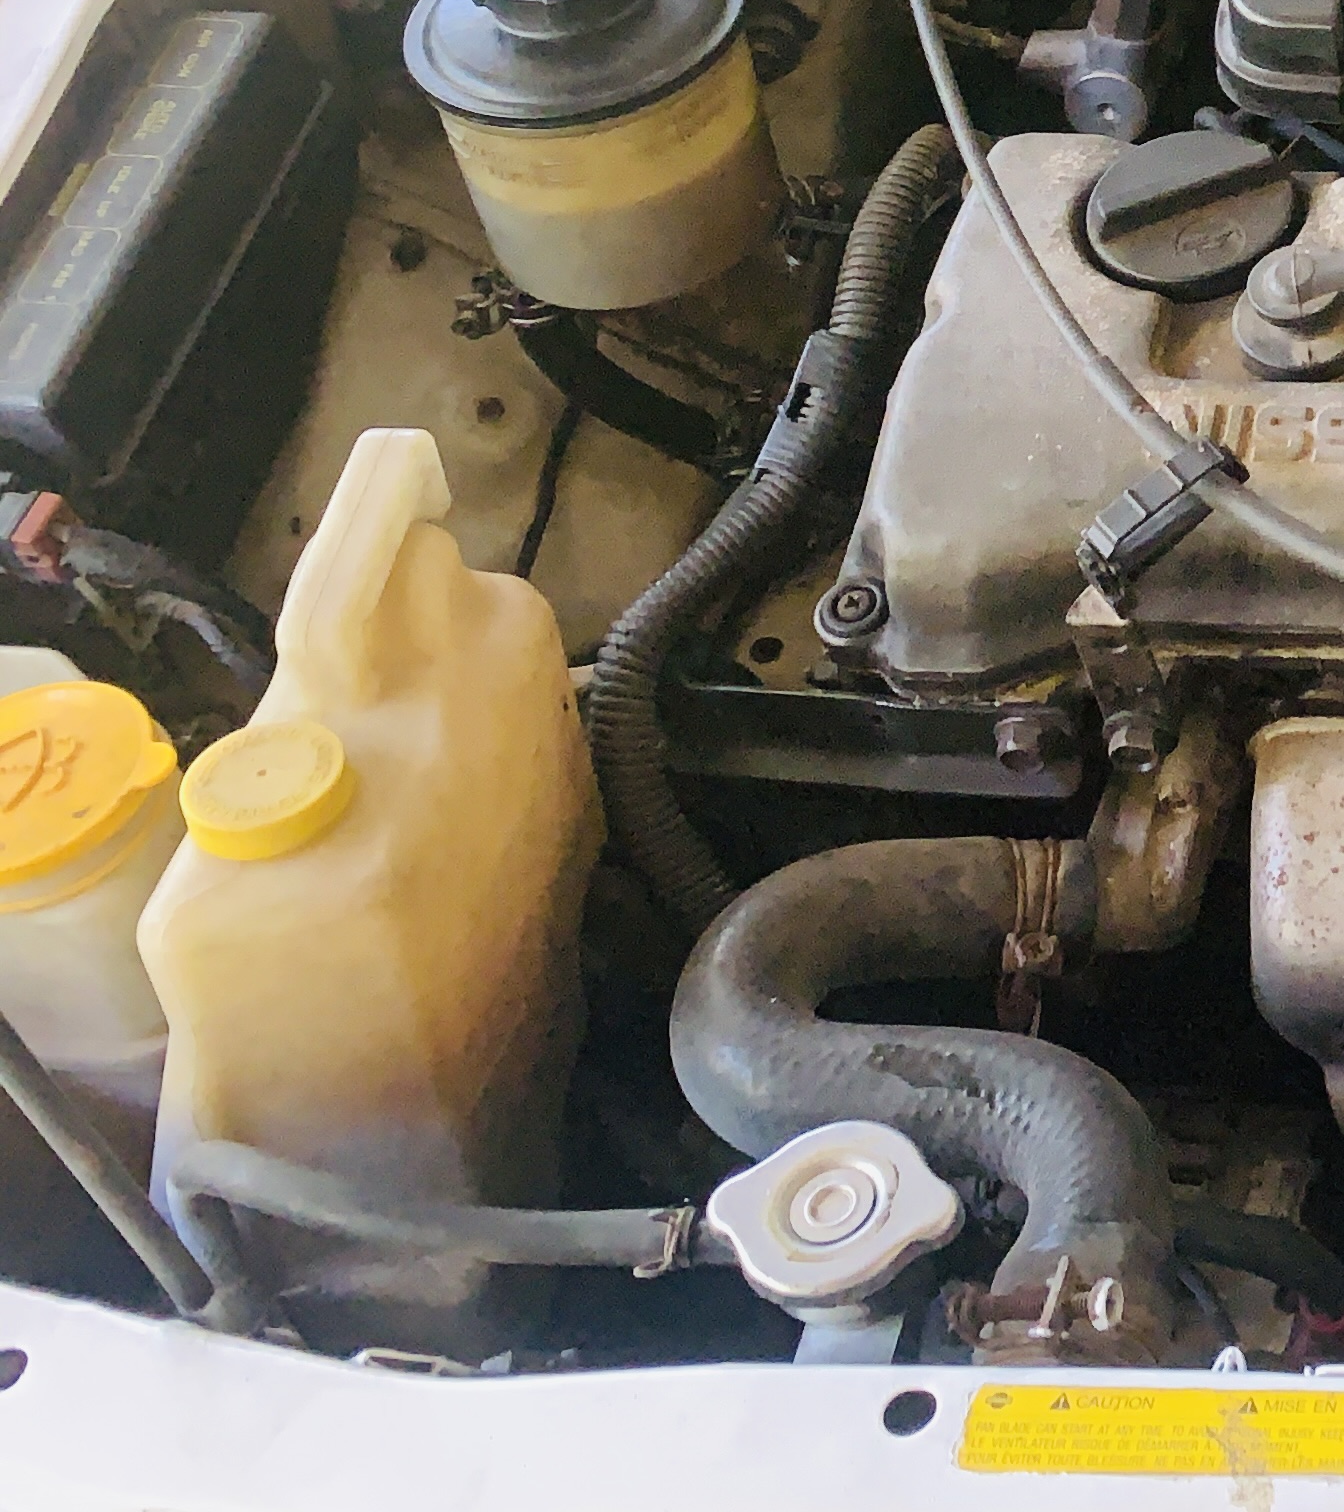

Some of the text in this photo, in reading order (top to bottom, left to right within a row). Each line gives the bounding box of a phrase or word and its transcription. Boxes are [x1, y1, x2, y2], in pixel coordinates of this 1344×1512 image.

[1076, 1396, 1156, 1411] CAUTION
[1263, 1399, 1308, 1414] MISE
[1314, 1399, 1338, 1414] EN
[1036, 1422, 1057, 1434] CAN
[1061, 1422, 1094, 1435] START
[1097, 1423, 1110, 1435] AT
[1115, 1423, 1136, 1436] ANY
